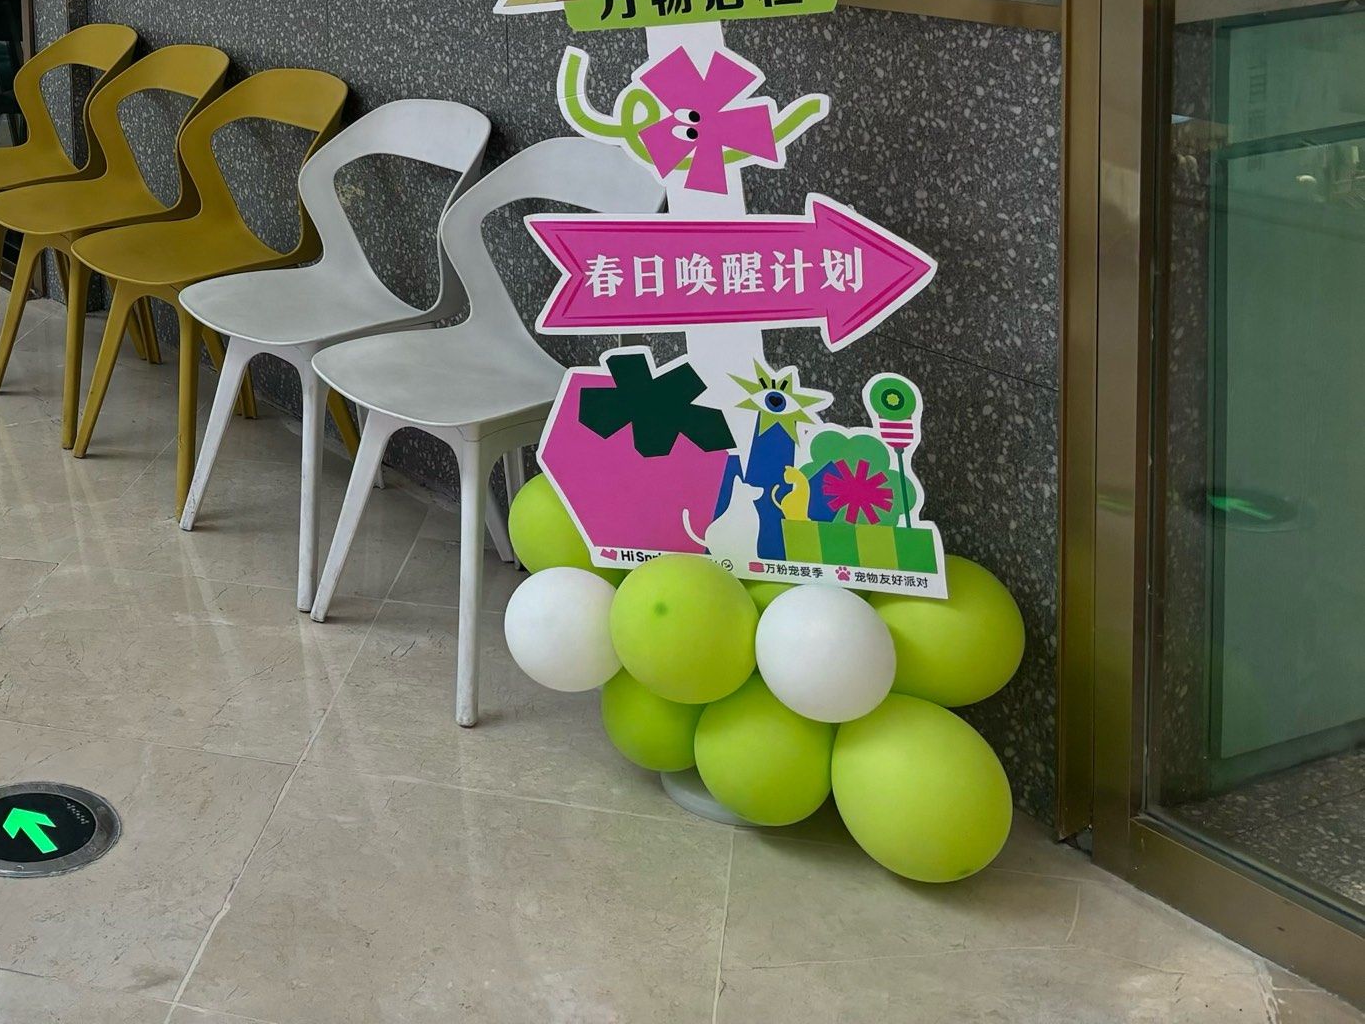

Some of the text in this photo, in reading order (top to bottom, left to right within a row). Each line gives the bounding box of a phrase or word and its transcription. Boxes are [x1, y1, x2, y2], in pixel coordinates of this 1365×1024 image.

[584, 247, 865, 298] 春日唤醒计划
[621, 550, 634, 562] Hi
[765, 563, 824, 579] 万粉宠爱季
[854, 571, 929, 589] 宠物友好派对
